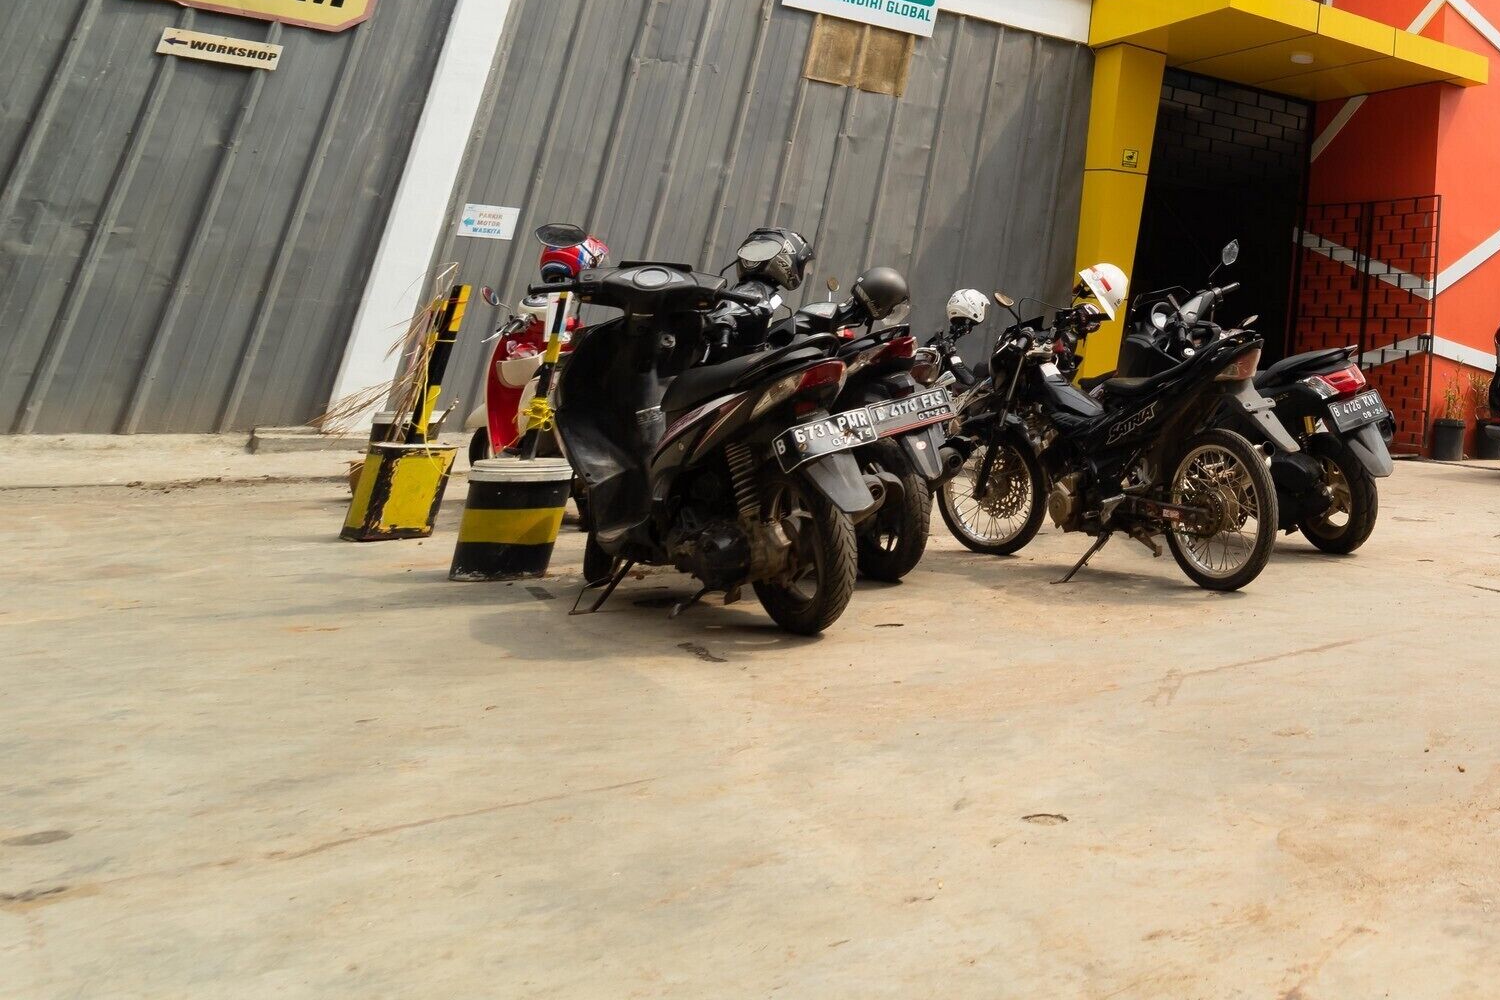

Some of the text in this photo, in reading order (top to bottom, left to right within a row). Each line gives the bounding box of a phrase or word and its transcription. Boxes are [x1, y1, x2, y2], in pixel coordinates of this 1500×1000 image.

[886, 0, 931, 22] GLOBAL
[190, 39, 278, 62] WORKSHOP
[478, 212, 503, 220] PARKIR
[472, 227, 502, 235] WASKITA
[921, 390, 944, 409] FAS
[1333, 406, 1341, 418] B
[1343, 401, 1361, 415] 4726
[776, 439, 786, 455] B
[794, 420, 834, 443] 6731
